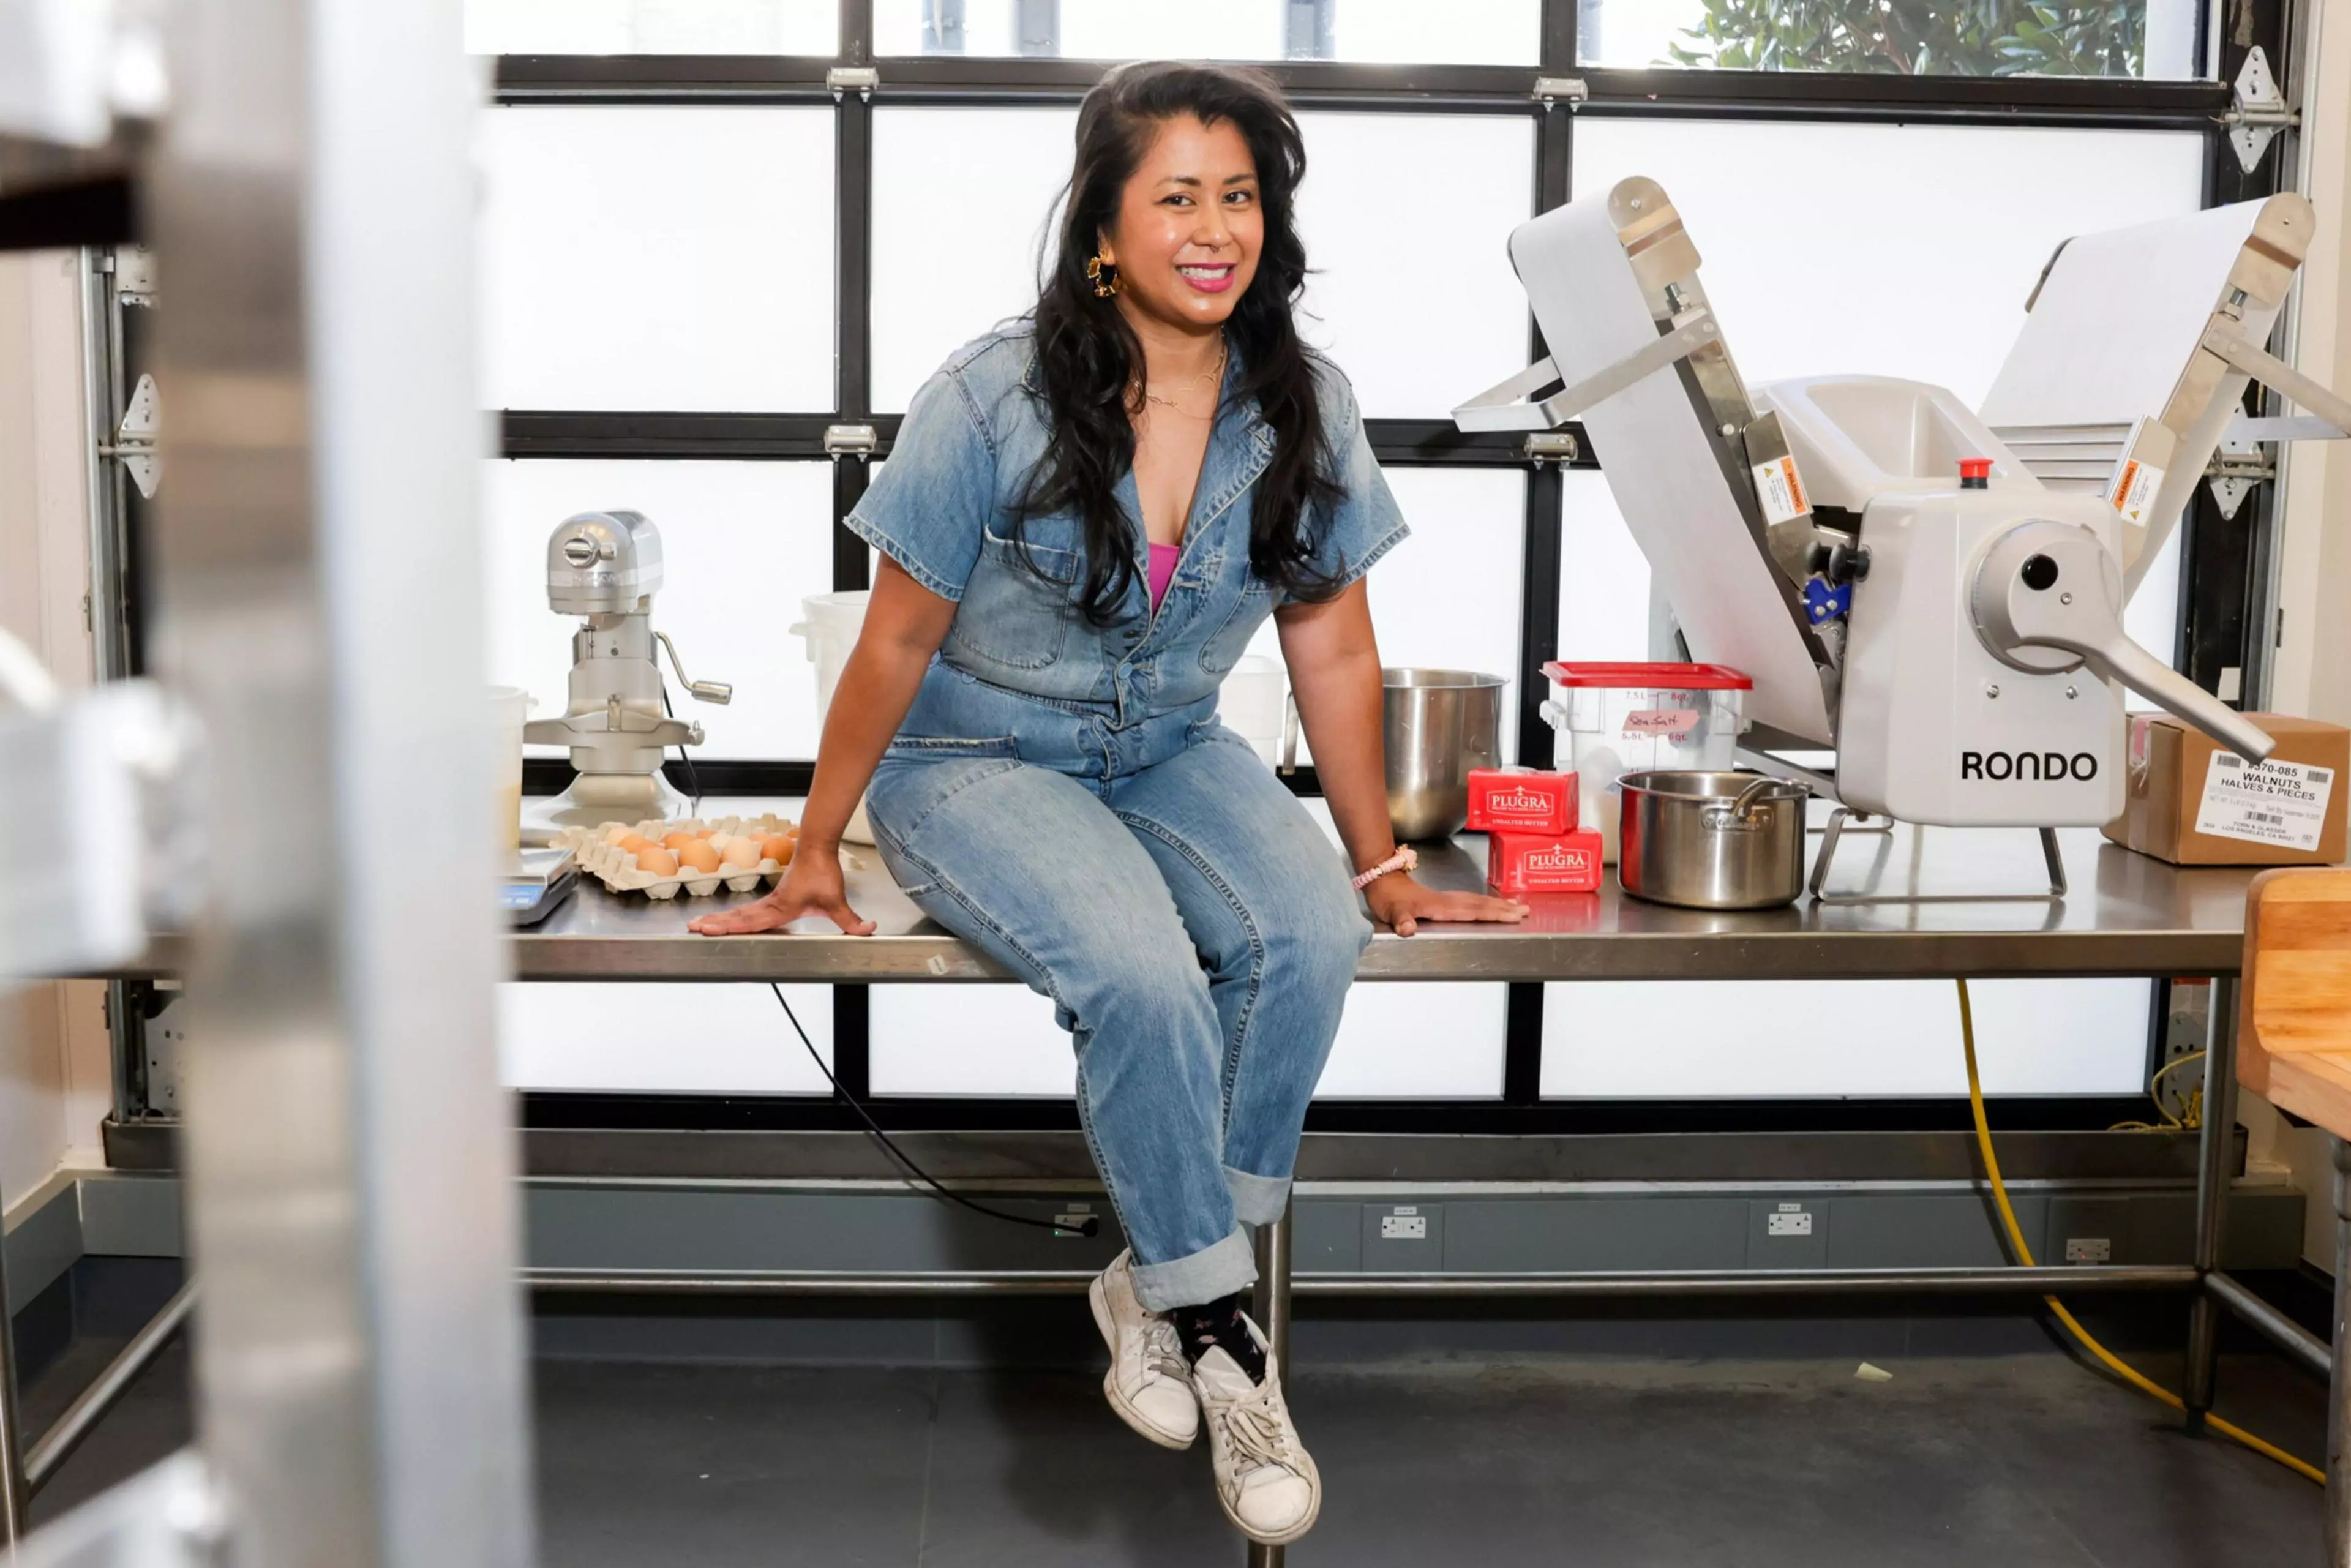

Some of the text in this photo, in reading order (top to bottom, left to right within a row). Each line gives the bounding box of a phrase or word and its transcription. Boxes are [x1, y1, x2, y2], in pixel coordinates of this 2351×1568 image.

[1788, 472, 1803, 508] WARNING
[2119, 467, 2134, 501] WARNING
[1629, 716, 1649, 726] Sea
[1962, 751, 2098, 781] RONDO
[2221, 778, 2263, 792] HALVES
[2277, 788, 2316, 801] PIECES
[2243, 772, 2301, 790] WALNUTS
[1492, 794, 1547, 808] PLUGRÀ
[1530, 852, 1584, 866] PLUGRÀ
